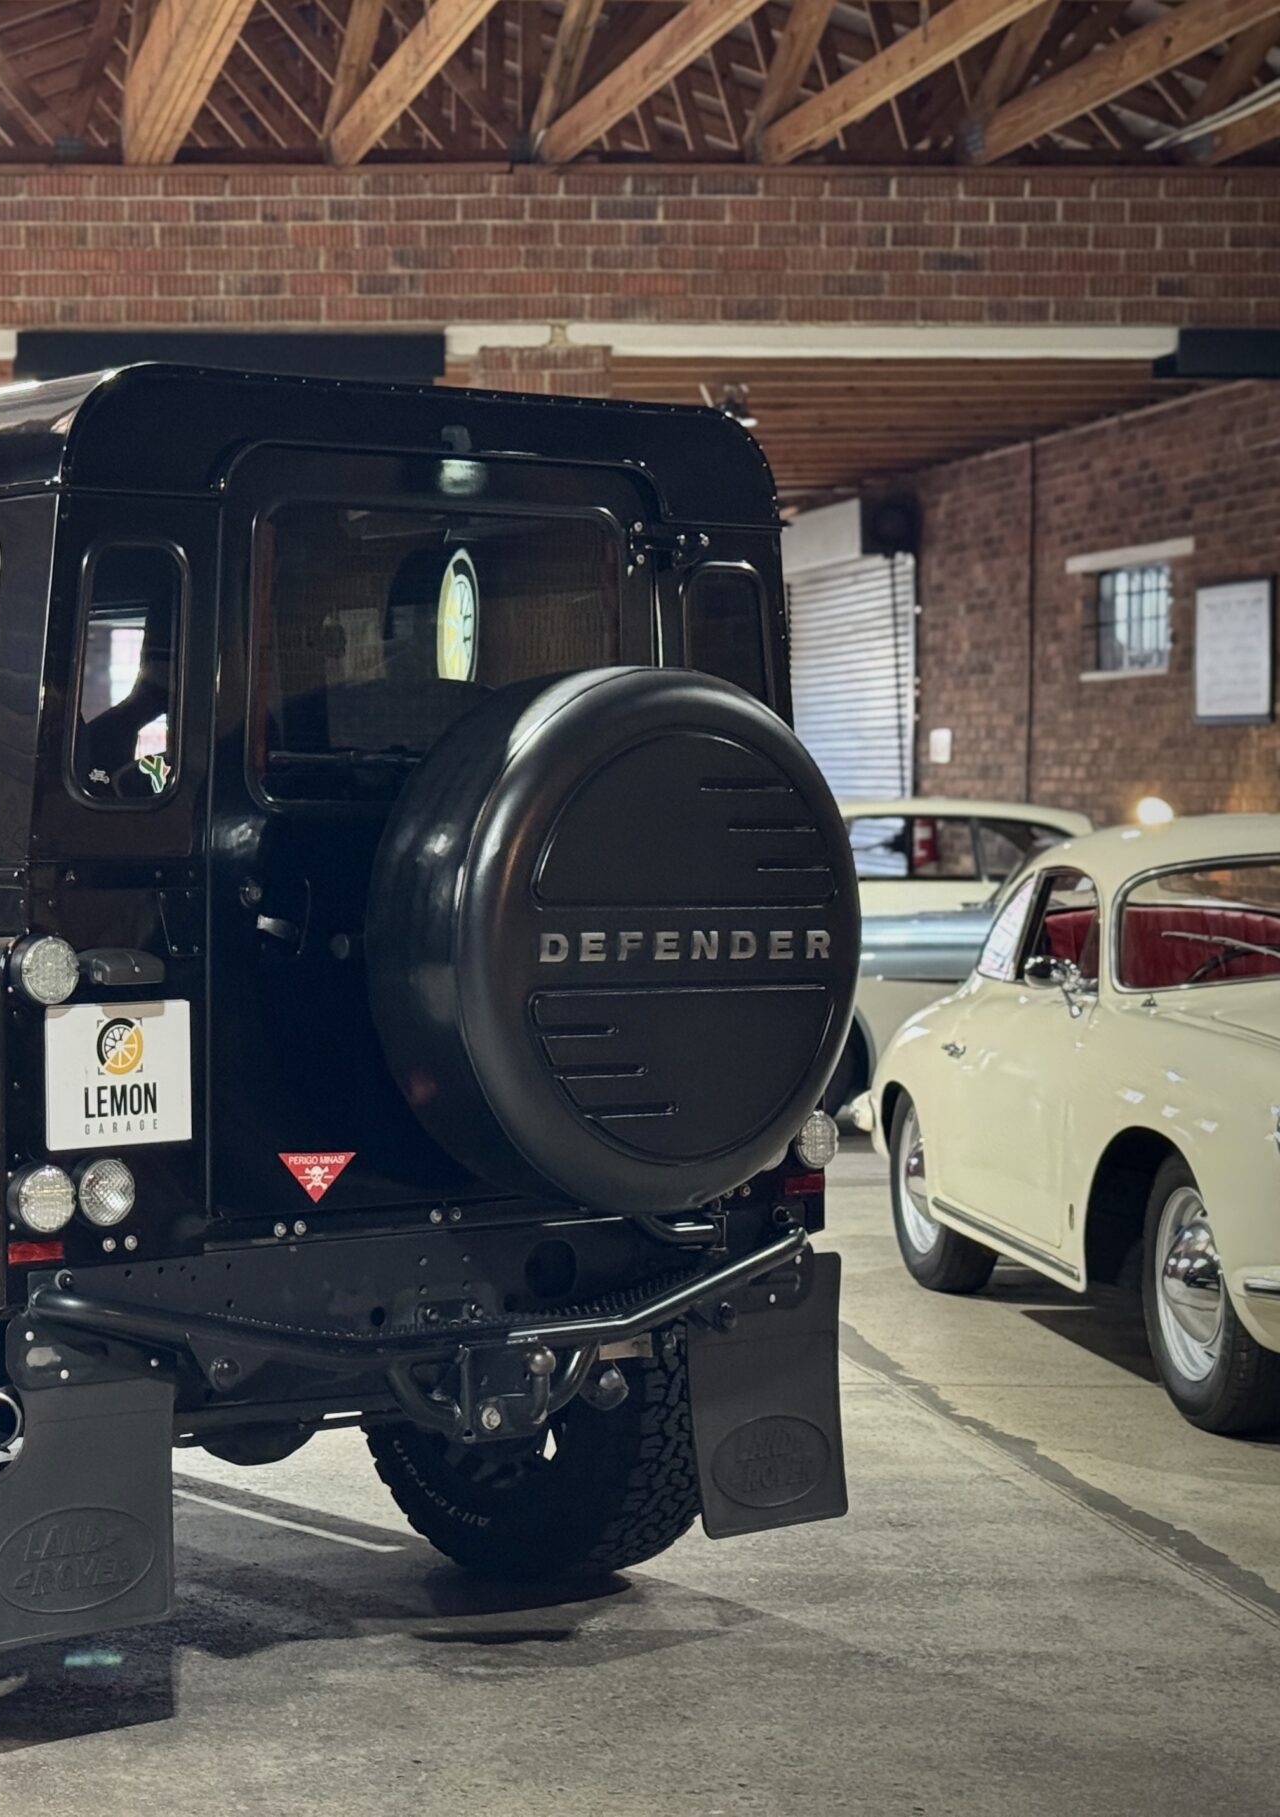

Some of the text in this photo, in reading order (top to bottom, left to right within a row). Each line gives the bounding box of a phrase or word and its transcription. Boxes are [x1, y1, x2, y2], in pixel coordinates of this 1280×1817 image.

[539, 930, 831, 963] DEFENDER
[84, 1082, 157, 1119] LEMON
[84, 1118, 158, 1136] GARAGE
[288, 1156, 318, 1165] PERIGO
